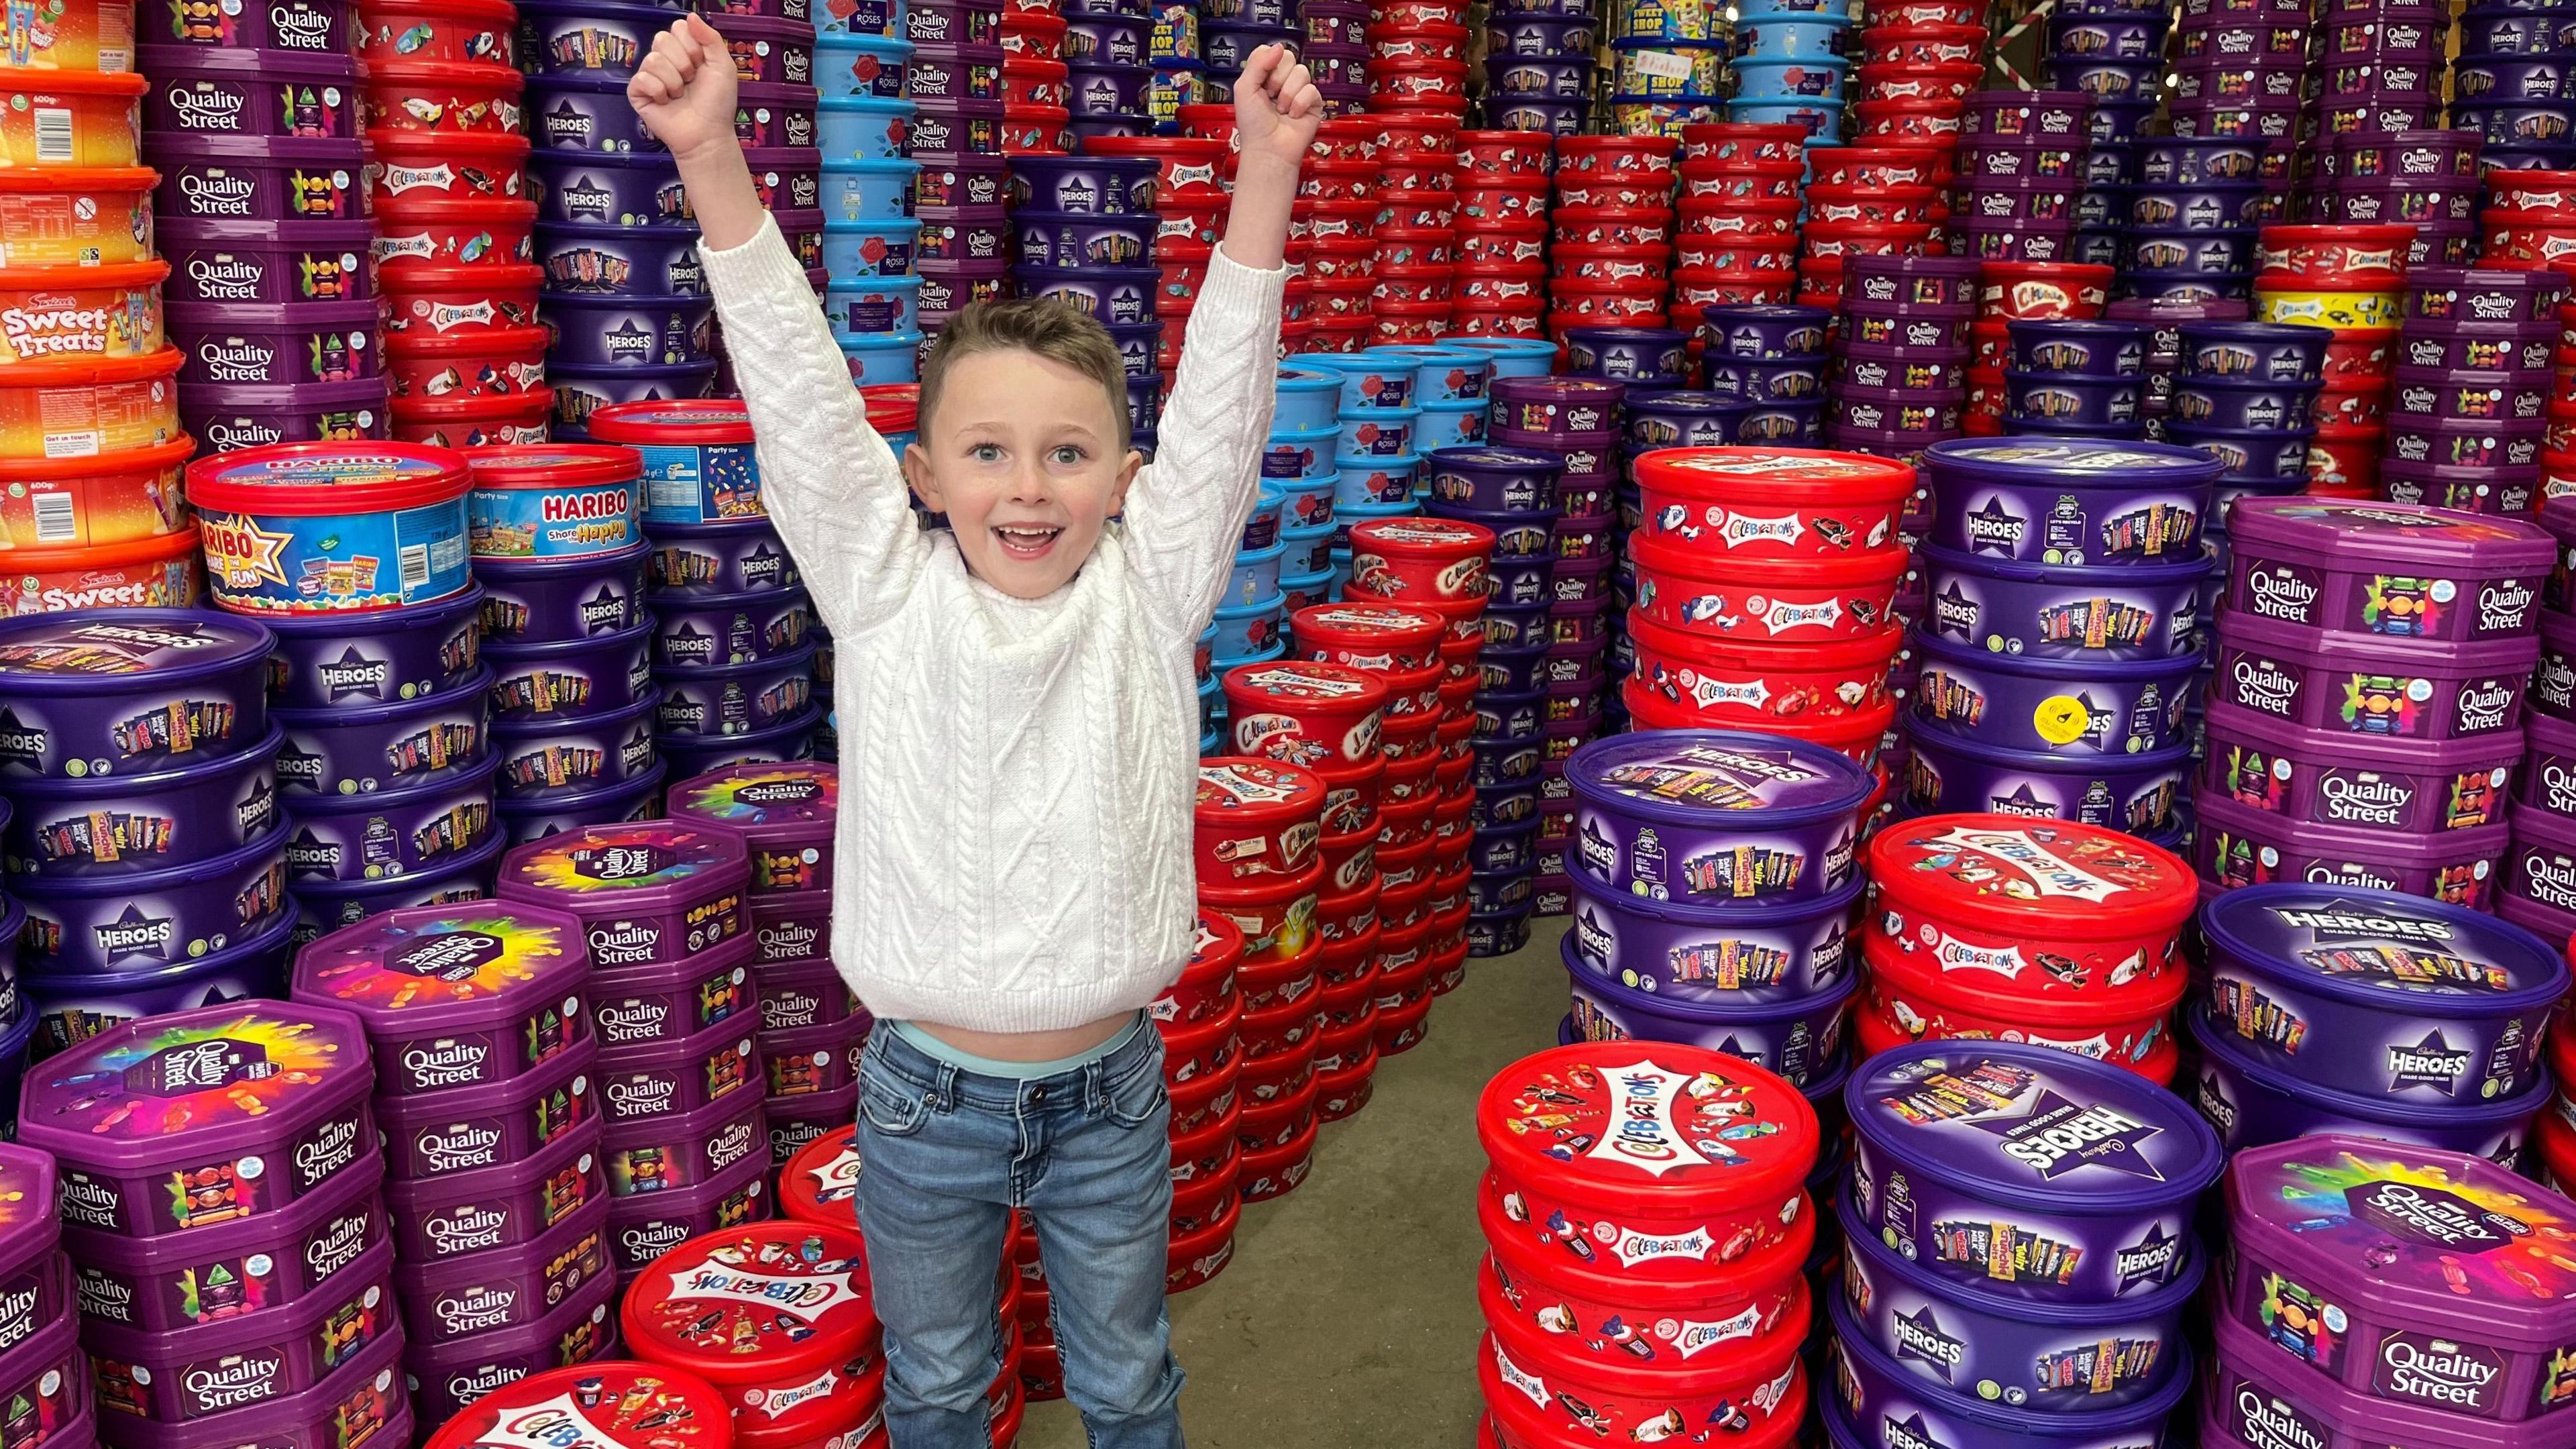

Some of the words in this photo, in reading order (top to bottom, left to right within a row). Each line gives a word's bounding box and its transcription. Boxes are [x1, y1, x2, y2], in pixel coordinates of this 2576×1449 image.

[271, 7, 331, 35] Quality
[857, 13, 881, 25] ROSES
[906, 13, 949, 31] Quality
[1633, 8, 1664, 18] SWEET
[910, 25, 946, 40] Street
[1633, 18, 1663, 30] SHOP
[279, 31, 328, 49] Street
[879, 78, 898, 89] ROSES
[1651, 76, 1685, 88] SHOP
[169, 89, 244, 115] Quality
[179, 113, 240, 130] Street
[547, 117, 590, 133] HEROES
[912, 123, 951, 140] Quality
[912, 136, 947, 149] Street
[180, 174, 255, 199] Quality
[190, 197, 251, 216] Street
[565, 192, 610, 208] HEROES
[189, 260, 262, 286] Quality
[885, 257, 905, 268] ROSES
[199, 282, 260, 300] Street
[1866, 289, 1894, 301] Street
[1, 308, 108, 335] Sweet
[11, 331, 106, 358] Treats
[606, 335, 651, 350] HEROES
[201, 345, 274, 366] Quality
[211, 363, 270, 381] Street
[1382, 391, 1400, 400] ROSES
[209, 424, 281, 445] Quality
[1379, 439, 1397, 449] ROSES
[708, 447, 727, 455] Party
[267, 457, 402, 468] HARIBO
[474, 492, 496, 500] Party
[544, 490, 628, 521] HARIBO
[549, 531, 577, 539] Share
[577, 519, 626, 545] Happy
[1968, 518, 2023, 541] HEROES
[203, 523, 253, 559] ARIBO
[742, 557, 780, 575] HEROES
[231, 569, 258, 585] FUN
[42, 582, 146, 612] Sweet
[2250, 571, 2318, 605] Quality
[2479, 585, 2534, 611] Quality
[582, 601, 624, 619] HEROES
[1936, 602, 1977, 625] HEROES
[2255, 594, 2309, 623] Street
[2479, 605, 2523, 630] Street
[665, 637, 712, 653] HEROES
[321, 664, 386, 686] HEROES
[2234, 661, 2300, 698] Quality
[2239, 684, 2290, 716] Street
[2459, 686, 2514, 714] Quality
[659, 704, 704, 721] HEROES
[2459, 706, 2504, 731] Street
[0, 734, 46, 753] EROES
[276, 758, 322, 775] EROES
[2322, 777, 2412, 807] Quality
[2328, 796, 2400, 825] Street
[97, 922, 171, 950] HEROES
[589, 926, 660, 949] Quality
[758, 926, 818, 948] Quality
[2396, 934, 2428, 943] TIMES
[598, 945, 656, 965] Street
[763, 943, 814, 959] Street
[598, 1005, 667, 1027] Quality
[760, 996, 820, 1017] Quality
[765, 1011, 815, 1028] Street
[607, 1023, 665, 1041] Street
[404, 1044, 487, 1071] Quality
[415, 1067, 484, 1088] Street
[608, 1080, 676, 1101] Quality
[615, 1097, 673, 1117] Street
[2053, 1105, 2075, 1119] SHARE
[2006, 1122, 2024, 1136] TIMES
[2025, 1114, 2052, 1127] GOOD
[296, 1118, 358, 1171] Quality
[419, 1130, 501, 1156] Quality
[707, 1122, 753, 1159] Quality
[305, 1144, 356, 1186] Street
[429, 1150, 496, 1172] Street
[712, 1142, 750, 1171] Street
[426, 1210, 506, 1236] Quality
[307, 1212, 369, 1263] Quality
[436, 1231, 503, 1254] Street
[623, 1226, 690, 1246] Quality
[315, 1237, 366, 1282] Street
[1998, 1229, 2009, 1275] crunchie
[437, 1289, 516, 1316] Quality
[445, 1311, 512, 1334] Street
[1903, 1342, 1917, 1352] SHARE
[1918, 1348, 1931, 1359] GOOD
[1931, 1354, 1946, 1366] TIMES
[2385, 1342, 2498, 1387] Quality
[186, 1358, 280, 1393] Quality
[199, 1379, 277, 1410] Street
[2390, 1371, 2481, 1407] Street
